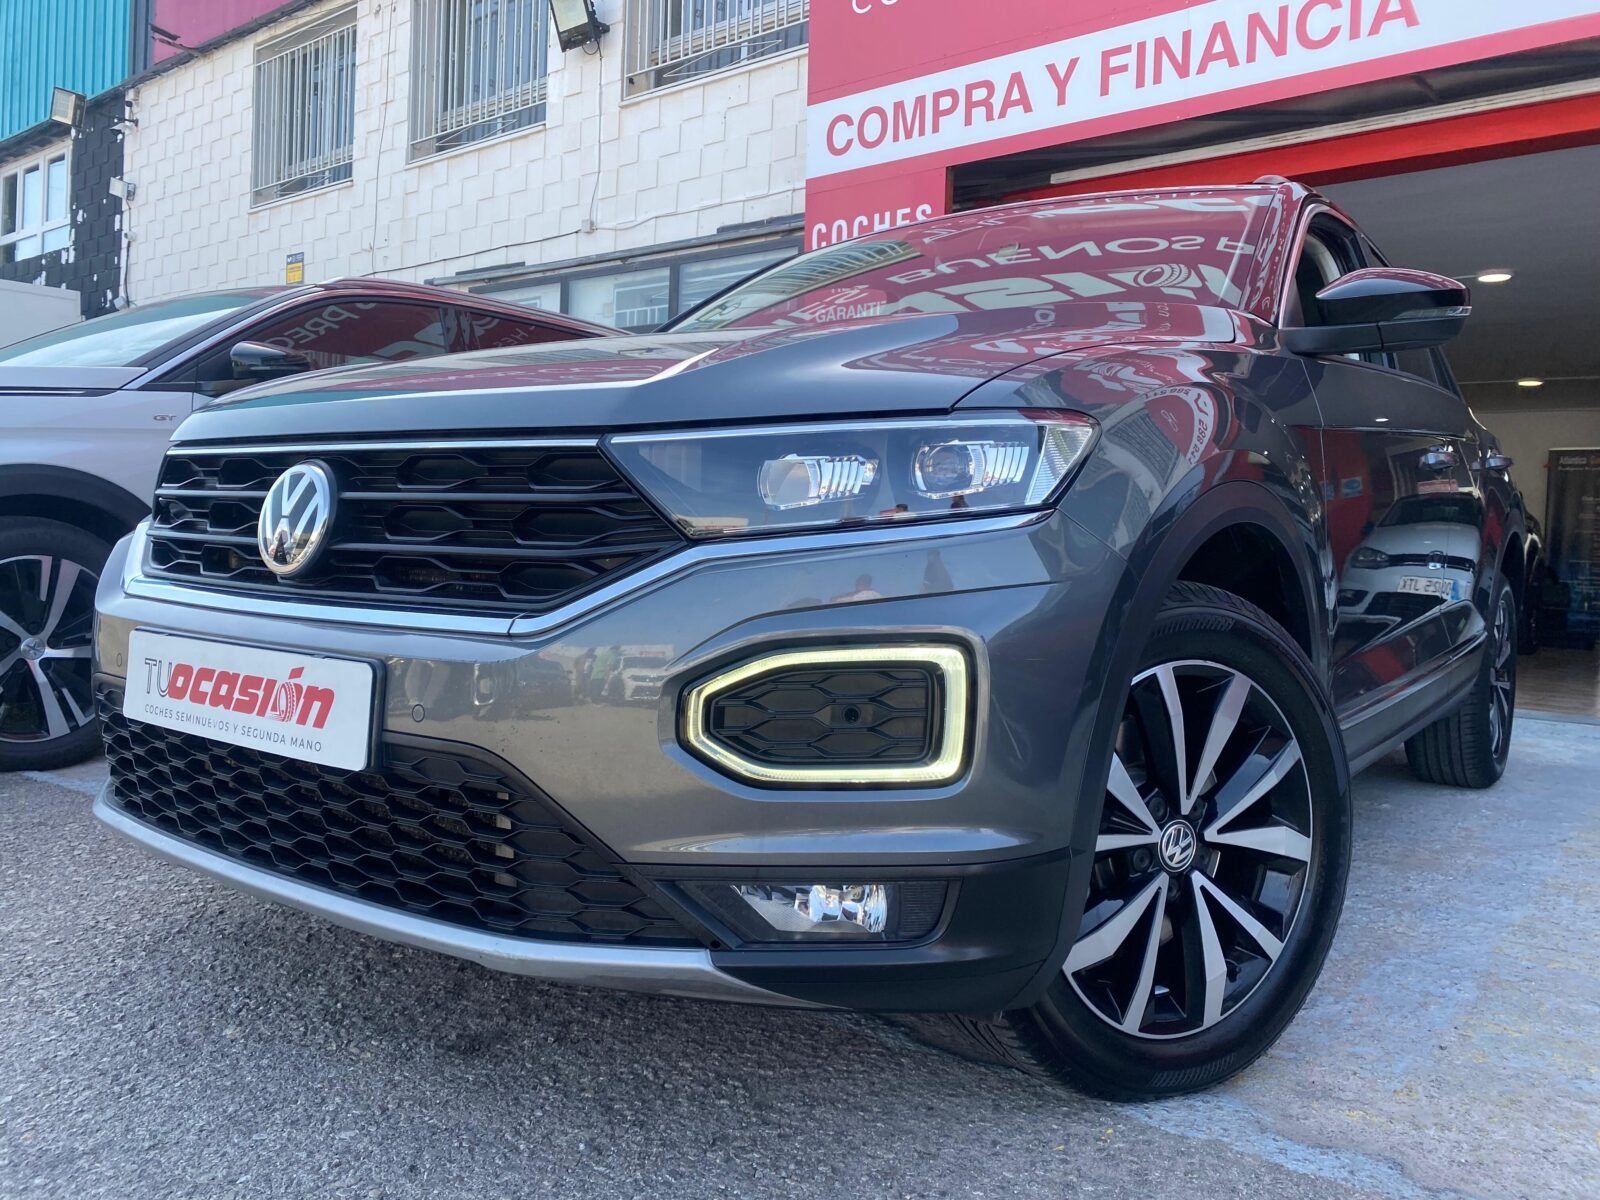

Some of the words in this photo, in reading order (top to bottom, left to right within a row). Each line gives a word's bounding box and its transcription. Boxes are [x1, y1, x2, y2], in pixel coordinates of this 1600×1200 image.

[826, 71, 1034, 157] COMPRA
[1045, 56, 1080, 106] Y
[1100, 0, 1420, 97] FINANCIA
[145, 704, 173, 719] COCHES
[176, 711, 229, 732] SEMINUEVOS
[233, 724, 239, 733] Y
[241, 726, 286, 745] SEGUNDA
[290, 736, 322, 752] MANO
